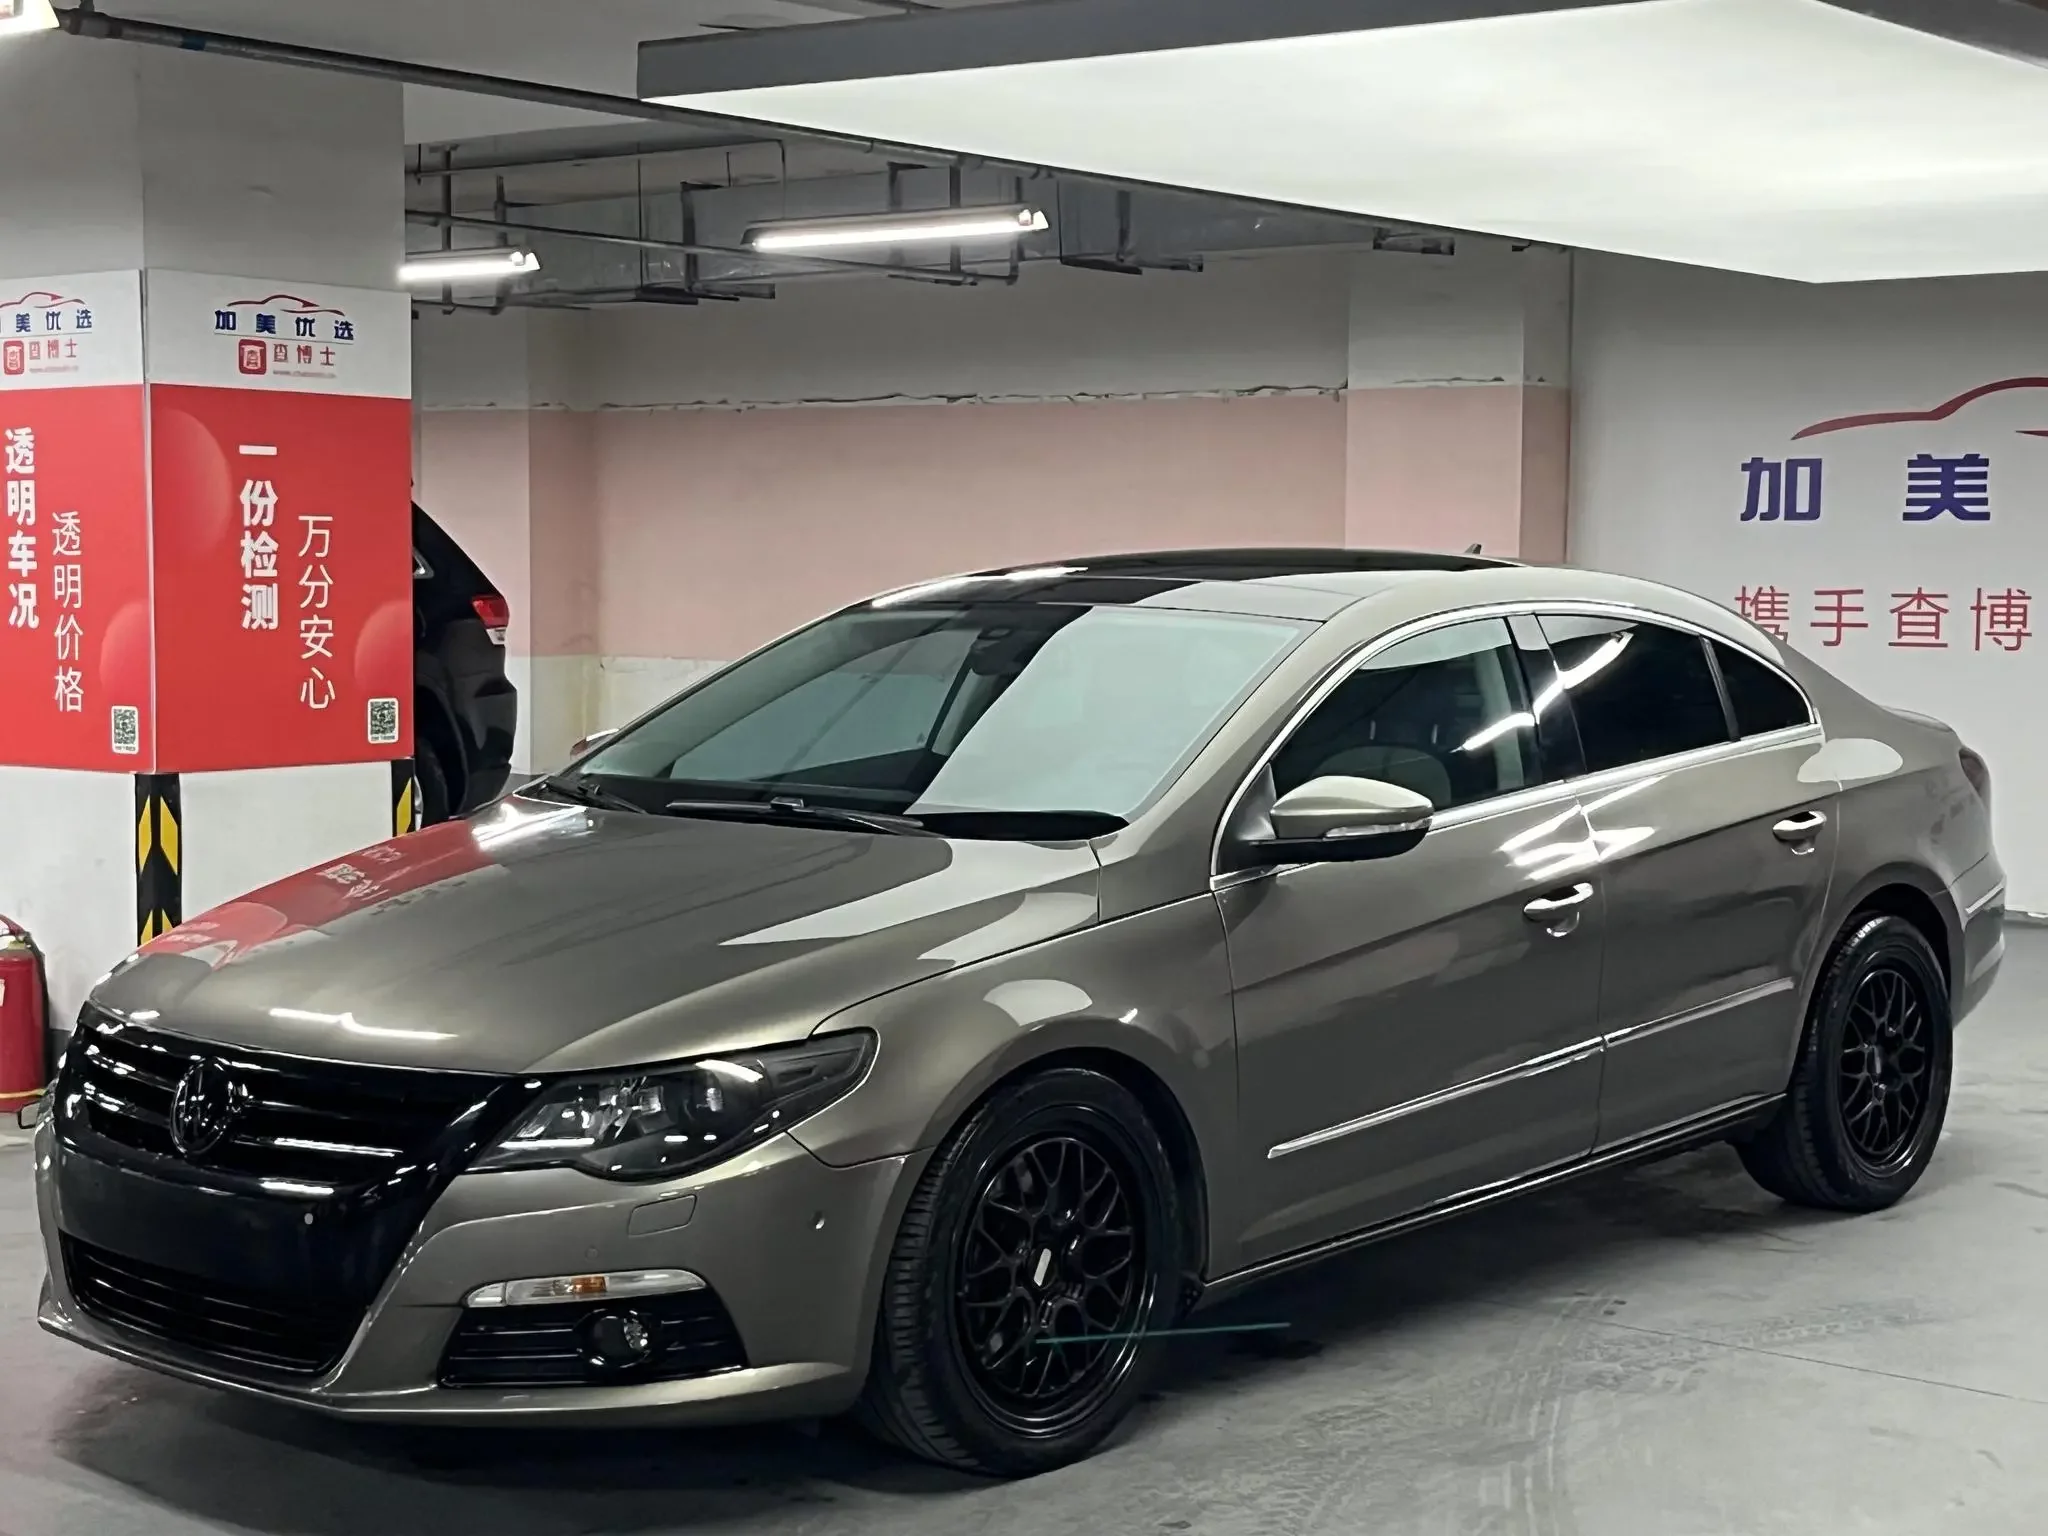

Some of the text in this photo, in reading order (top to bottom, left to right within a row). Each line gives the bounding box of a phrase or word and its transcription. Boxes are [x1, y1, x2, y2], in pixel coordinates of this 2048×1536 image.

[0, 308, 92, 333] 美优选
[214, 309, 354, 341] 加美优选
[273, 343, 336, 366] 查博士
[1740, 453, 1991, 522] 加美
[5, 426, 40, 629] 透明车况
[238, 444, 279, 631] 一份检测
[51, 510, 84, 713] 透明价格
[297, 514, 336, 710] 万分安心
[1734, 585, 2033, 652] 携手查博
